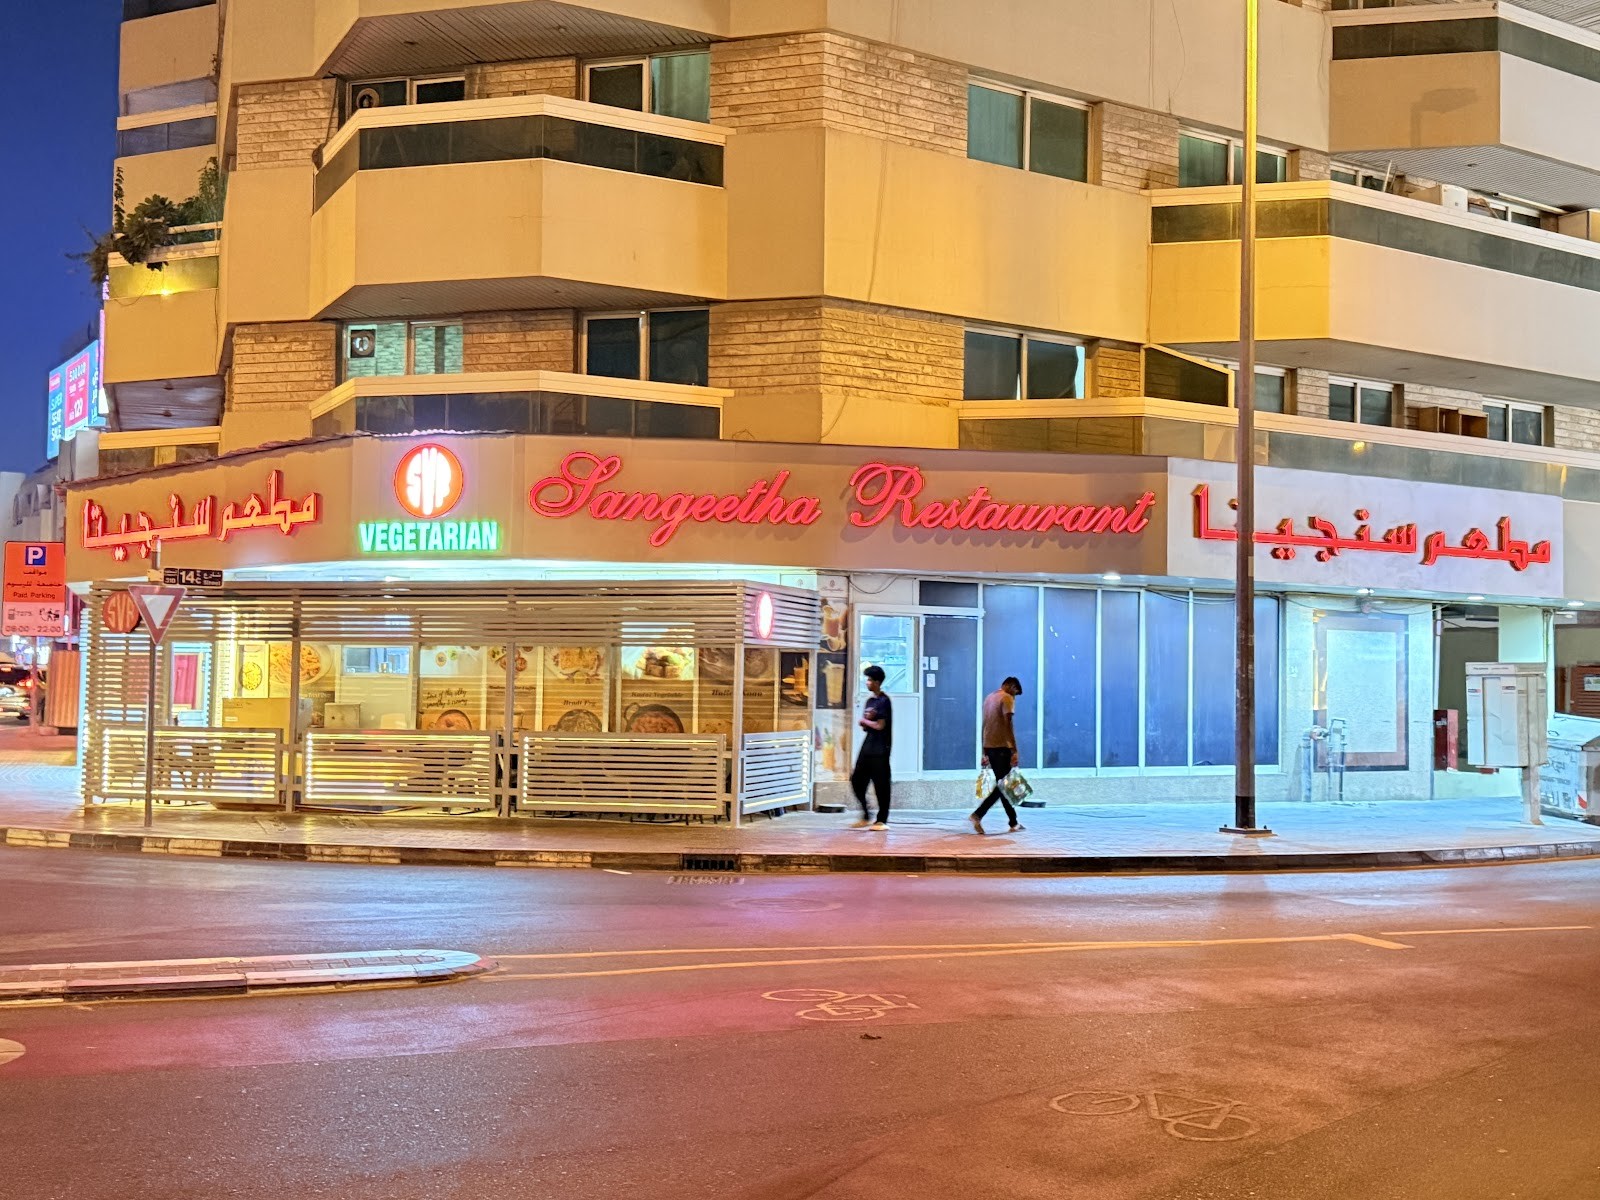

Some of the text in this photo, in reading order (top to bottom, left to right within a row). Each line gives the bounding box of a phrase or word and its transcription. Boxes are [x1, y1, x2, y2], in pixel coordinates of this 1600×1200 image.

[83, 470, 318, 561] مطعم سنجيتا
[528, 451, 1156, 546] Sangeetha Restaurant
[1192, 484, 1551, 571] مطعم سنجيا
[27, 547, 43, 564] P
[359, 521, 498, 552] VEGETARIAN
[37, 625, 61, 633] 22:00
